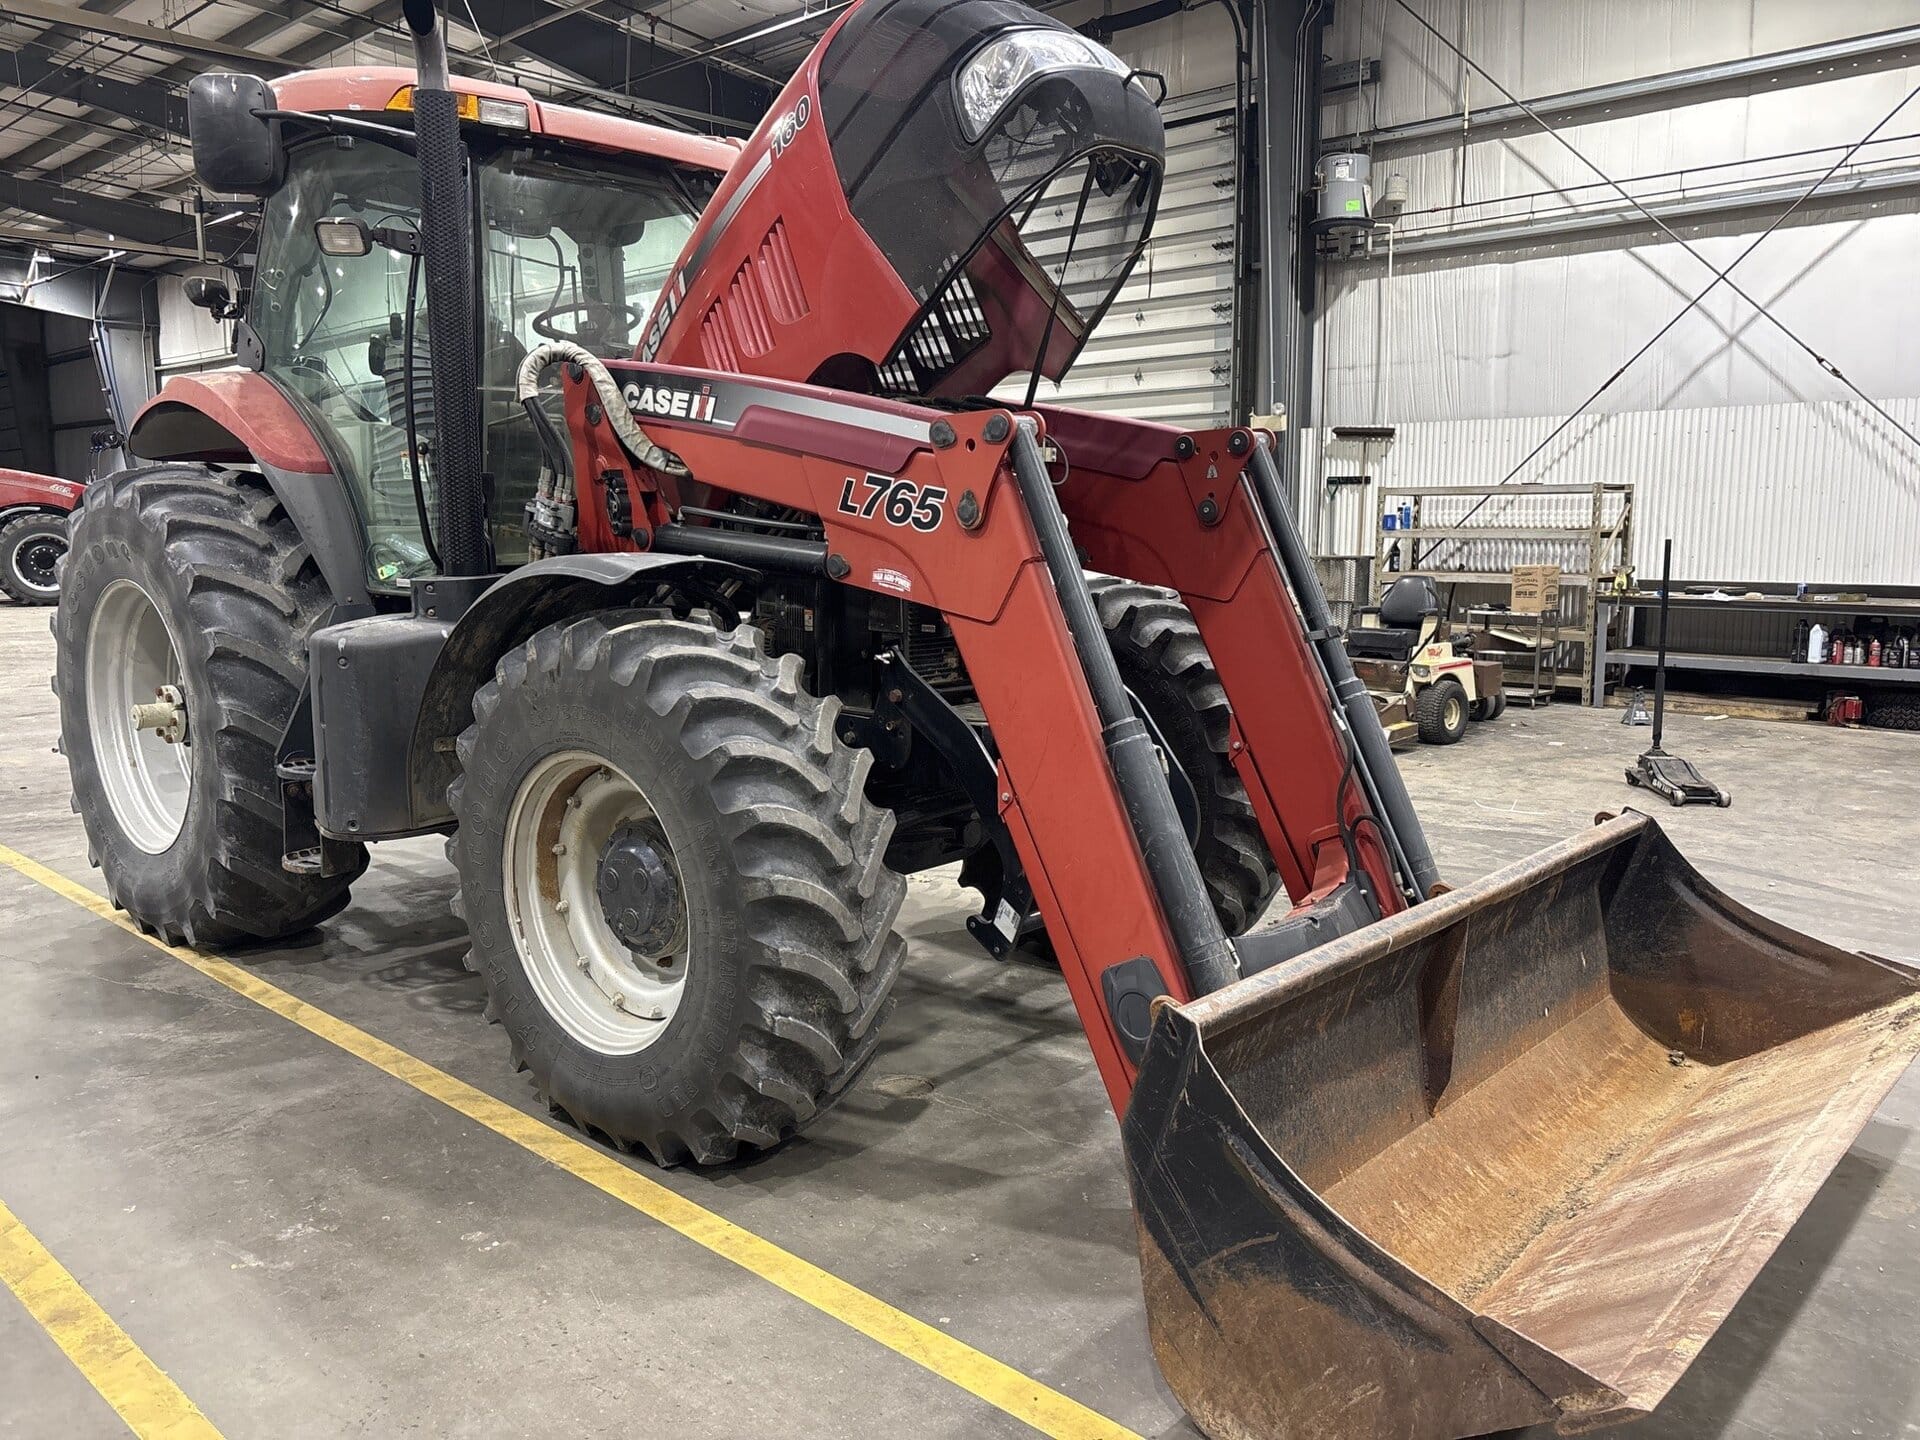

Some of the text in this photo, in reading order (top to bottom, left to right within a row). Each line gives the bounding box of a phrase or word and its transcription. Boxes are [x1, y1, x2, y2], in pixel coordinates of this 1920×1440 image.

[771, 94, 812, 160] 160
[640, 301, 674, 364] ASE
[622, 383, 690, 418] CASE
[837, 471, 949, 533] L765
[465, 728, 540, 1053] Firestone
